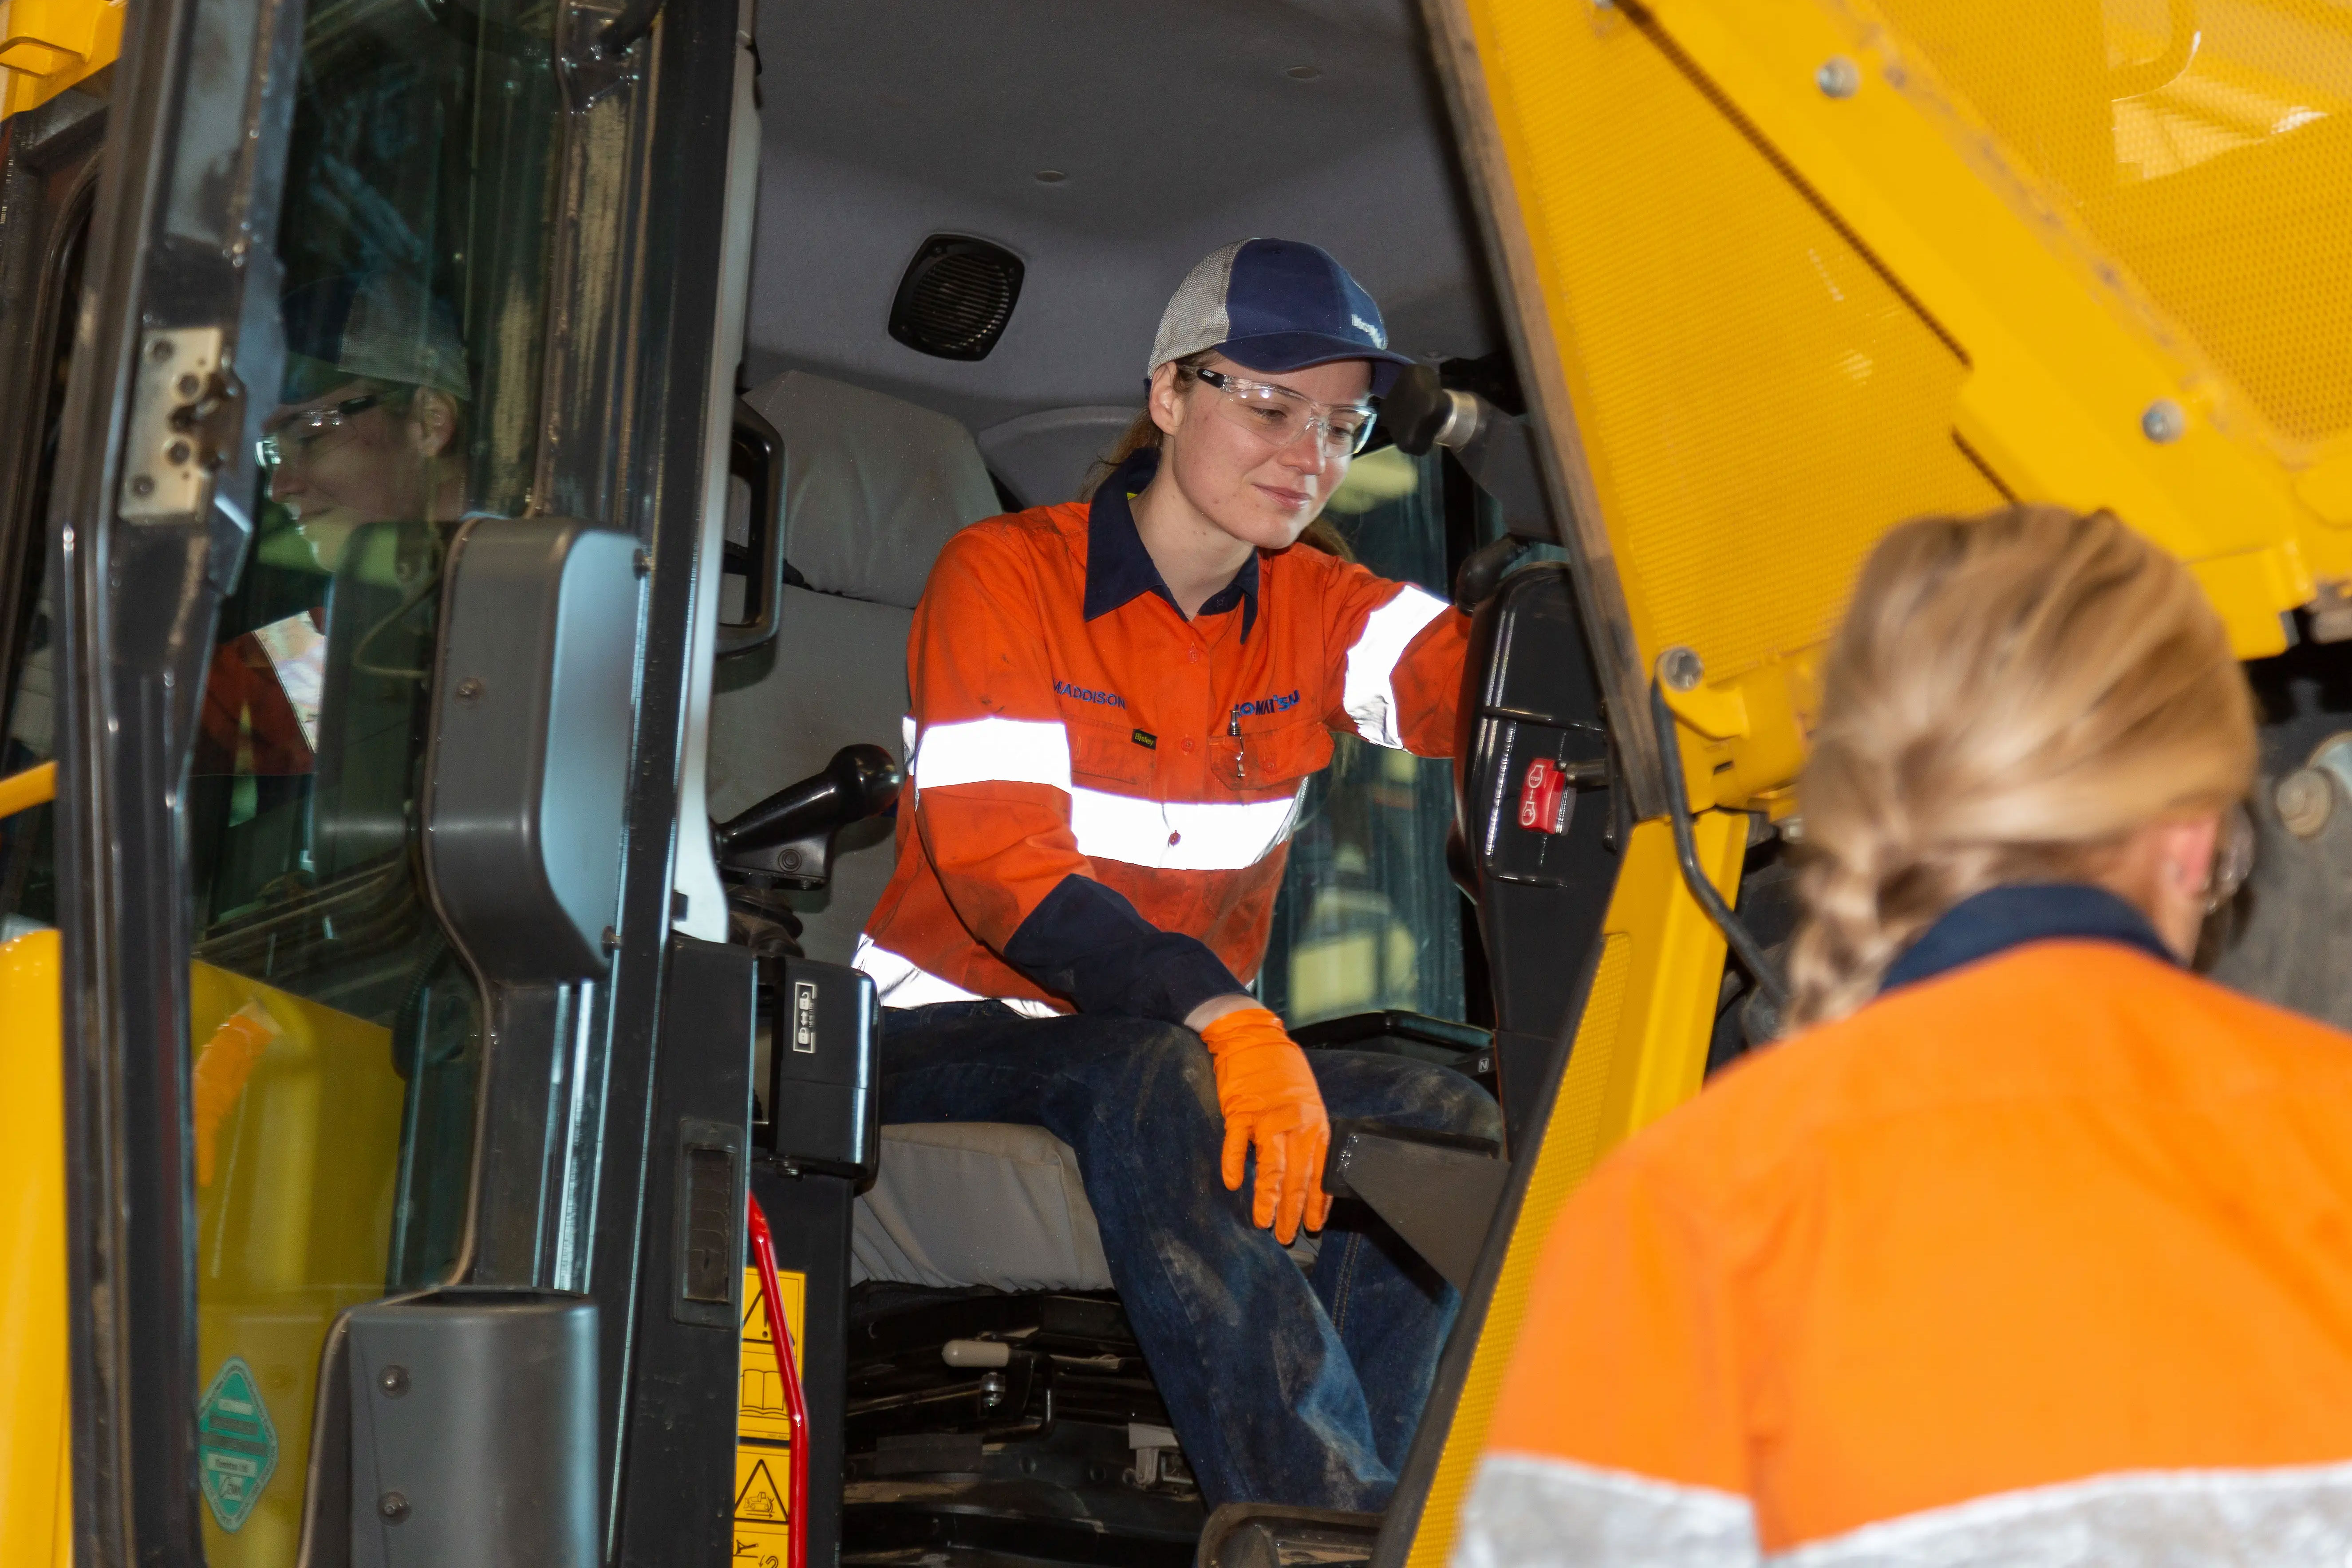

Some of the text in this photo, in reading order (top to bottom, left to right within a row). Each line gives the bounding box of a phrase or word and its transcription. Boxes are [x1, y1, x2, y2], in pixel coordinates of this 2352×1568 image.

[1053, 679, 1126, 710] MADDISON
[1135, 733, 1154, 746] Bisley
[1480, 1060, 1488, 1070] N
